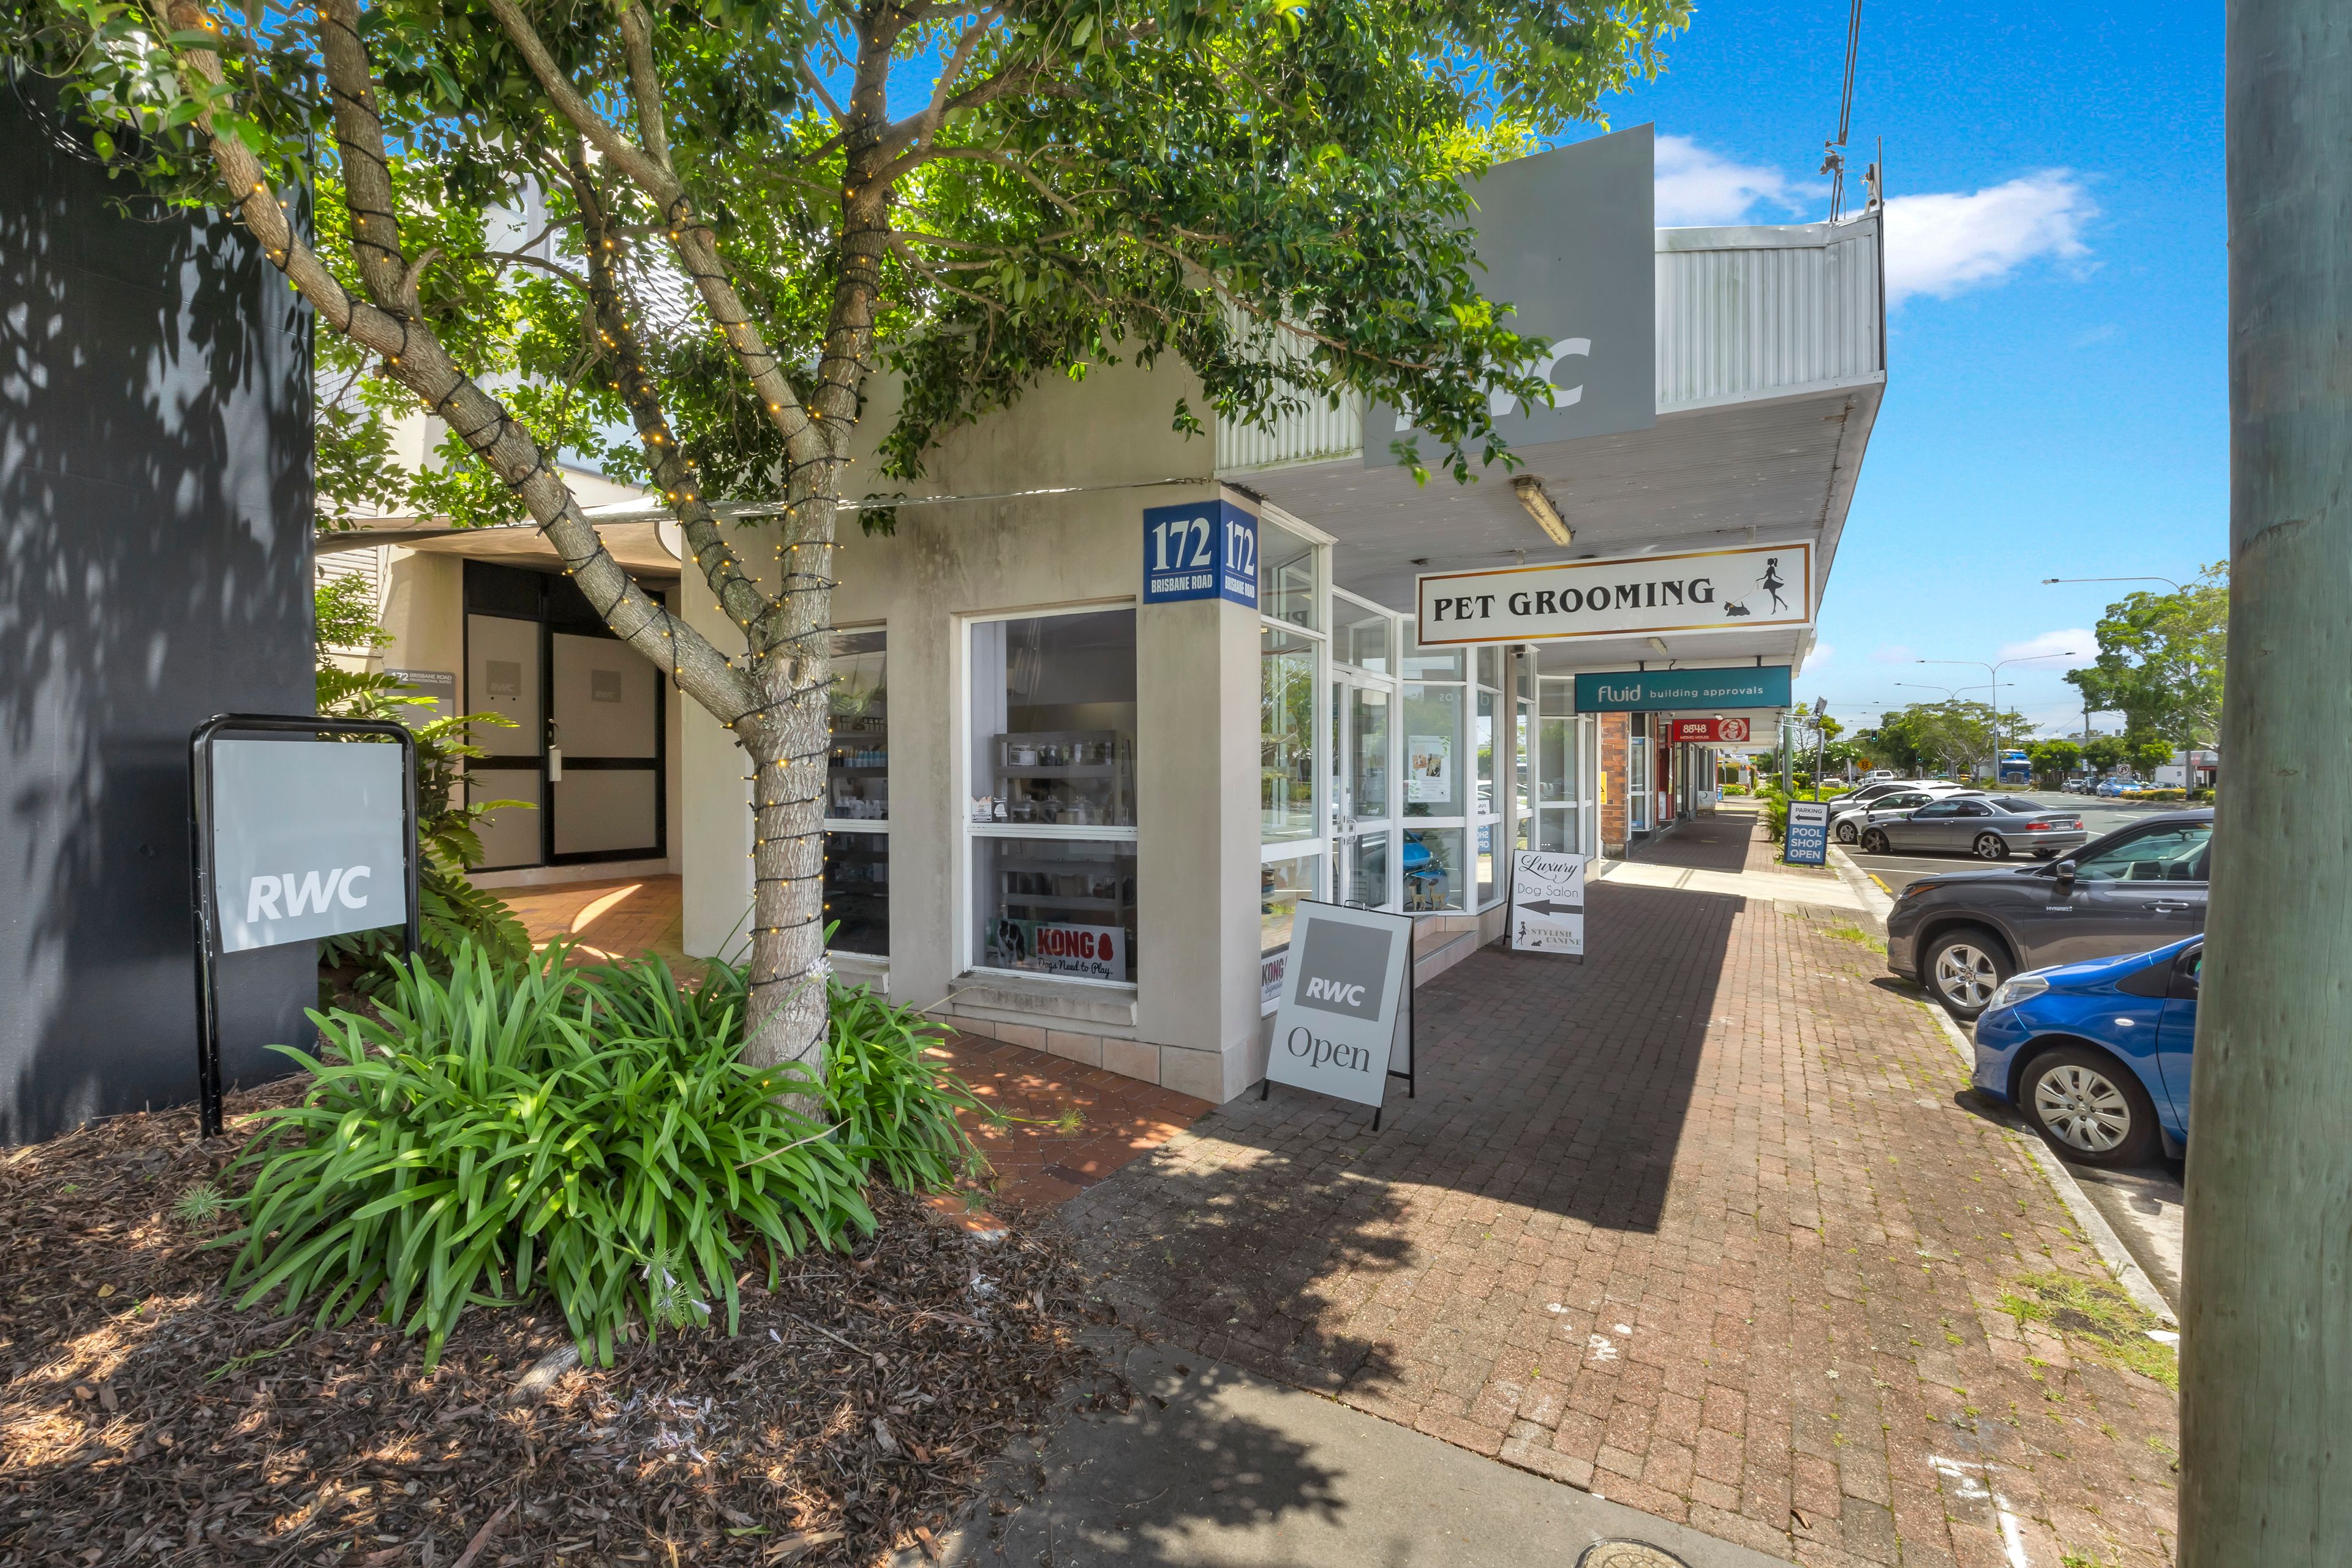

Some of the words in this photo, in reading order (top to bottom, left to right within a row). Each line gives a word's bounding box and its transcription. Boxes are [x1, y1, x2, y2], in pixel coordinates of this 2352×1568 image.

[1152, 518, 1212, 570] 172
[1226, 521, 1254, 576] 172
[1152, 576, 1189, 593] BRISBANE
[1191, 575, 1213, 589] ROAD
[1225, 575, 1244, 595] BRISBANE
[1245, 582, 1254, 598] ROAD
[1434, 594, 1495, 621] PET
[1509, 578, 1715, 616] GROOMING
[1598, 685, 1640, 703] fluid
[1650, 689, 1698, 698] building
[1703, 686, 1763, 697] approvals
[1790, 838, 1822, 848] SHOP
[1792, 827, 1822, 837] POOL
[1790, 849, 1820, 859] OPEN
[1519, 855, 1578, 884] Luxury
[246, 865, 371, 923] RWC
[1518, 883, 1541, 896] Dog
[1546, 885, 1578, 898] Salon
[1037, 928, 1094, 959] KONG
[1531, 929, 1572, 938] STYLISH
[1546, 937, 1581, 945] CANINE
[1038, 958, 1057, 973] Dogs
[1058, 959, 1079, 971] Need
[1080, 962, 1089, 972] to
[1262, 958, 1284, 987] KONG
[1306, 977, 1365, 1006] RWC
[1288, 1027, 1370, 1072] Open
